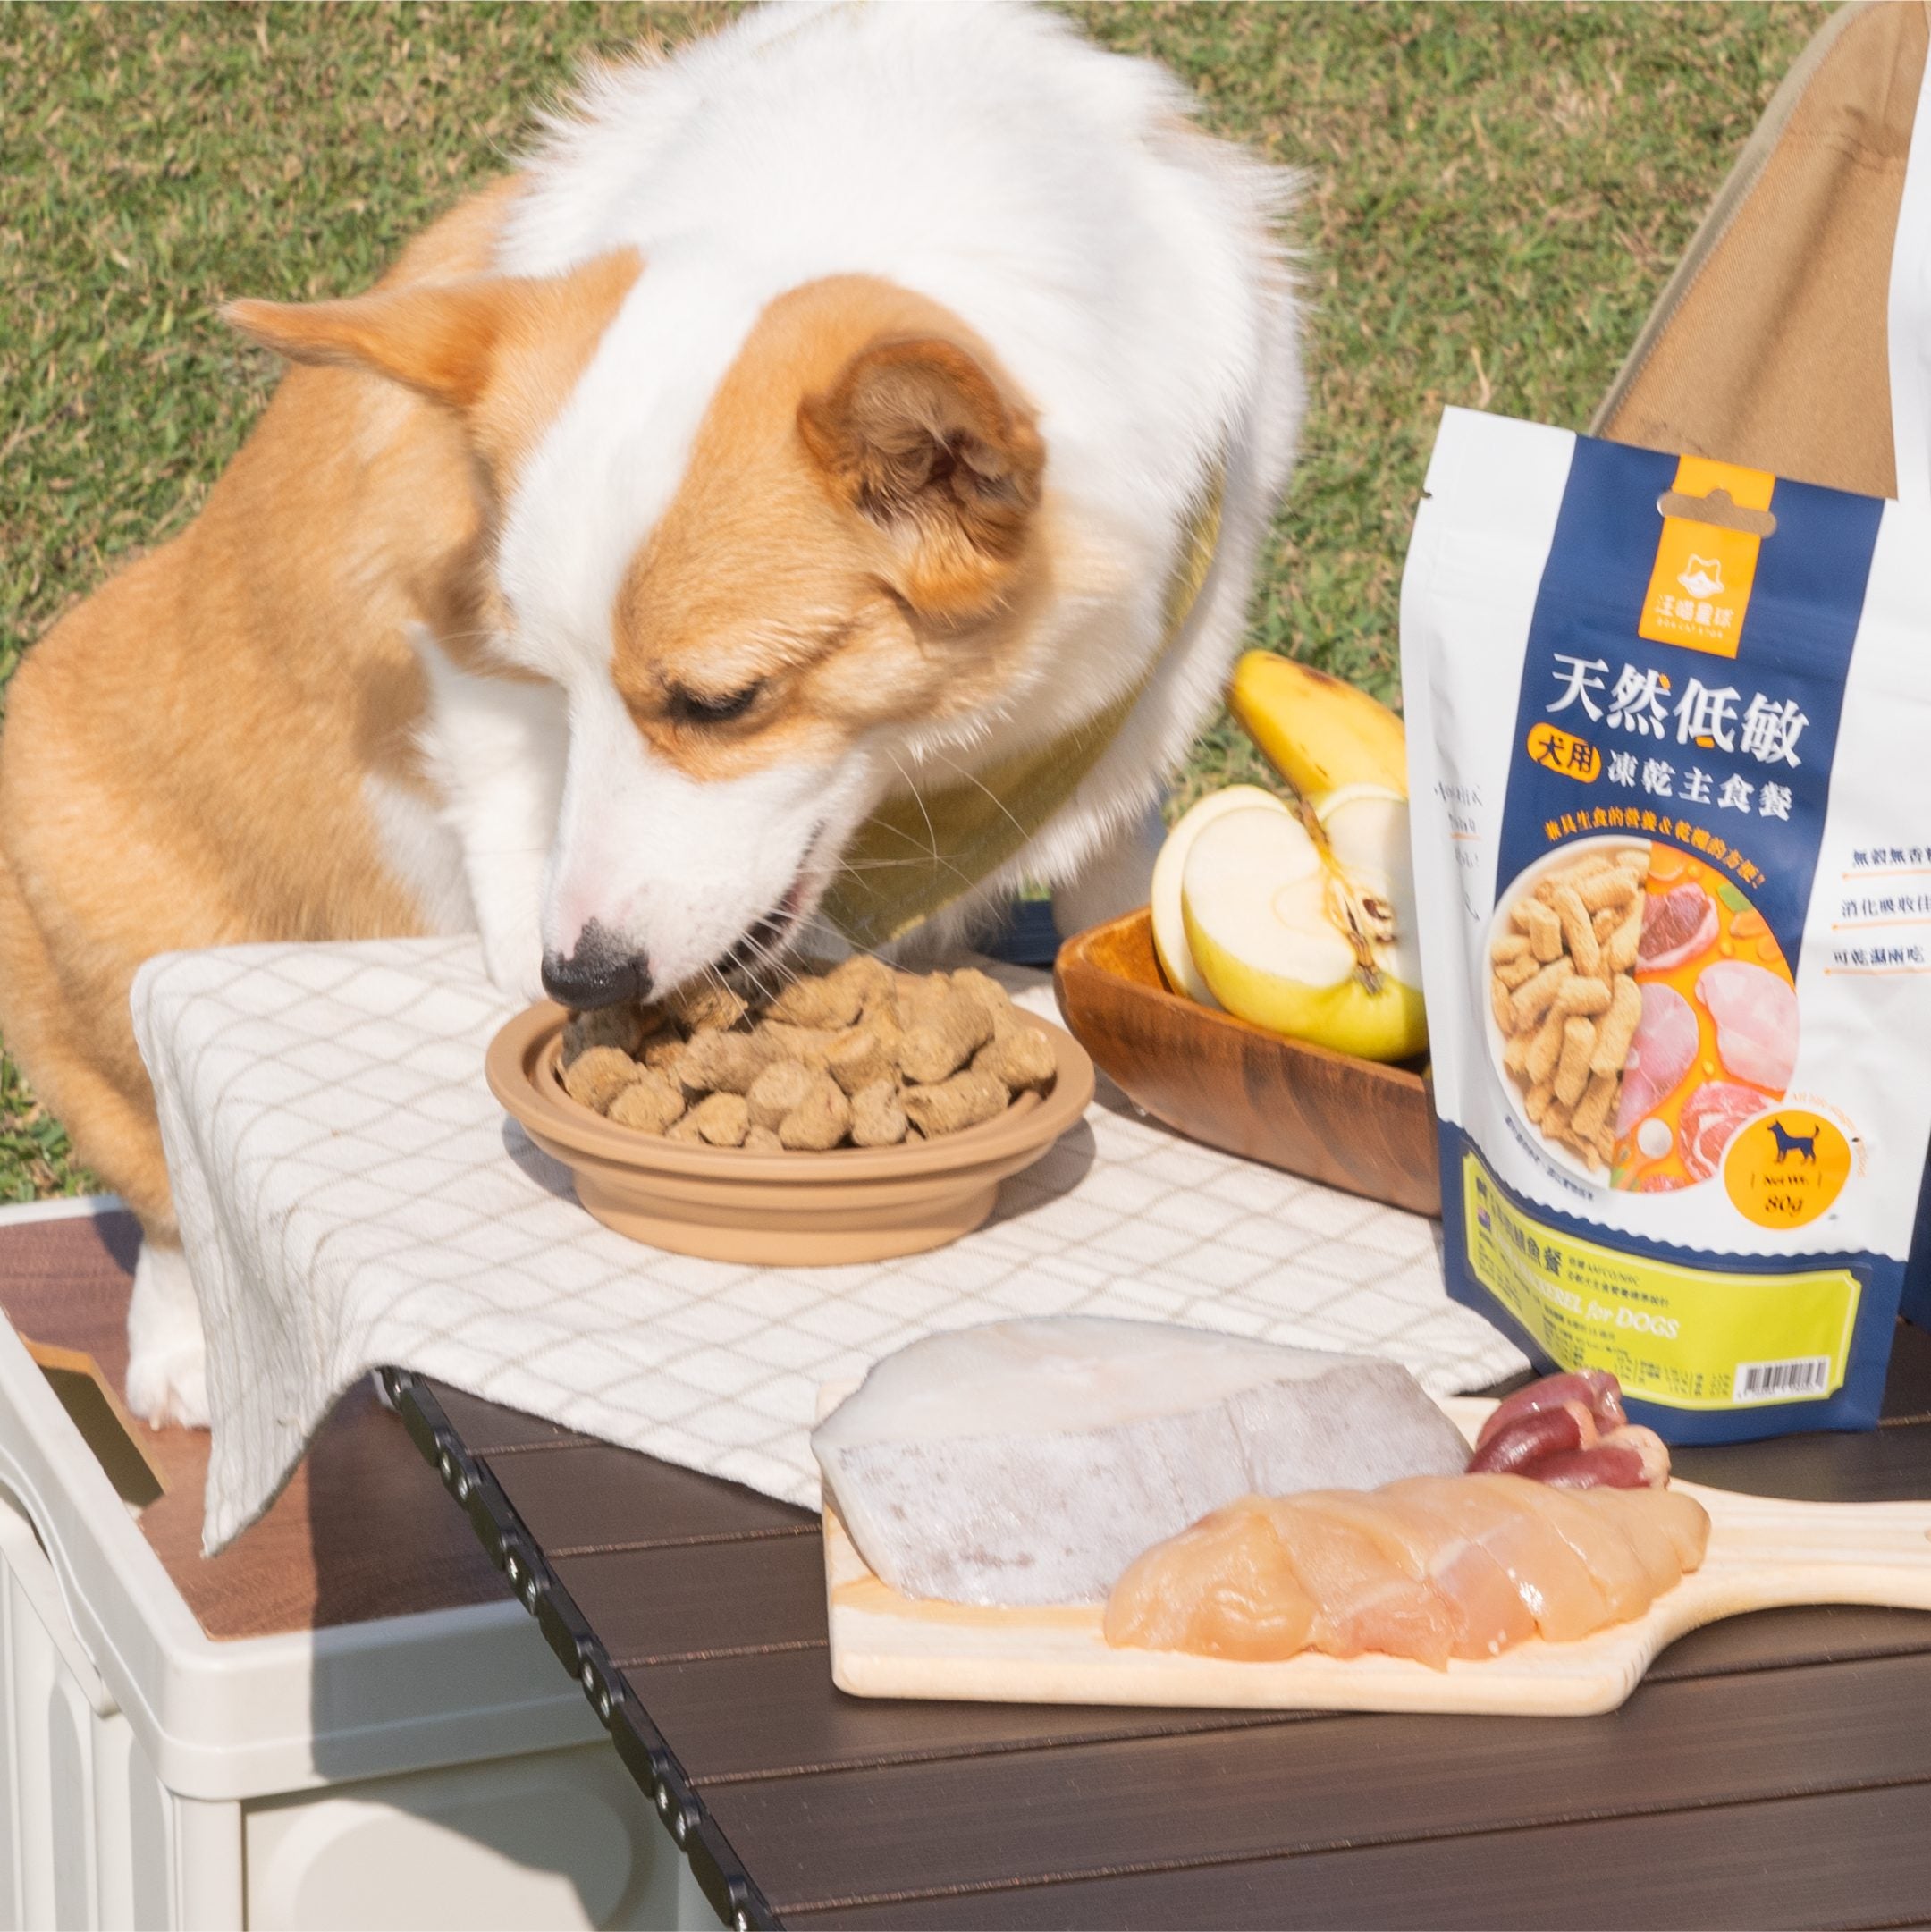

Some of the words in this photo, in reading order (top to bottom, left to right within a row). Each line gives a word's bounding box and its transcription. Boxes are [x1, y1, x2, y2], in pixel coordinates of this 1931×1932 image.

[1545, 653, 1809, 769] 天然低敏
[1539, 733, 1596, 773] 犬用
[1607, 749, 1792, 822] 凍乾主食餐
[1585, 1299, 1613, 1323] for
[1615, 1305, 1681, 1341] DOGS
